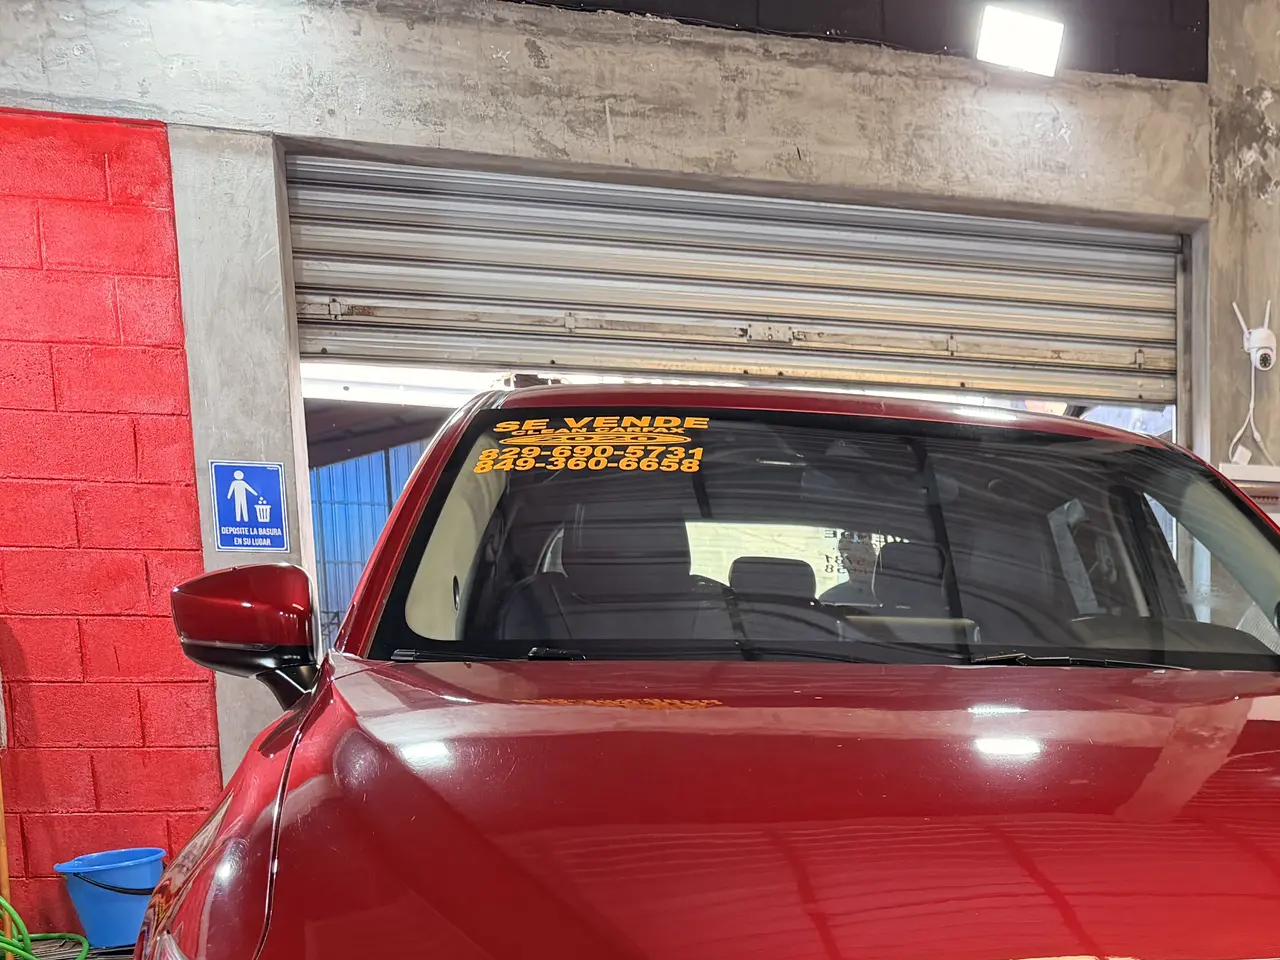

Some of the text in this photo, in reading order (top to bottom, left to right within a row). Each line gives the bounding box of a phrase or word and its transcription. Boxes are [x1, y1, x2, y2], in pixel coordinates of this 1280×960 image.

[493, 416, 709, 432] SE VENDE
[511, 427, 686, 436] CLEAN CARFAX
[479, 446, 703, 461] 829-690-5731
[474, 457, 700, 473] 849-360-6658
[221, 526, 282, 536] DEPOSITE LA BASURA
[234, 537, 272, 546] EN SU LUGAR
